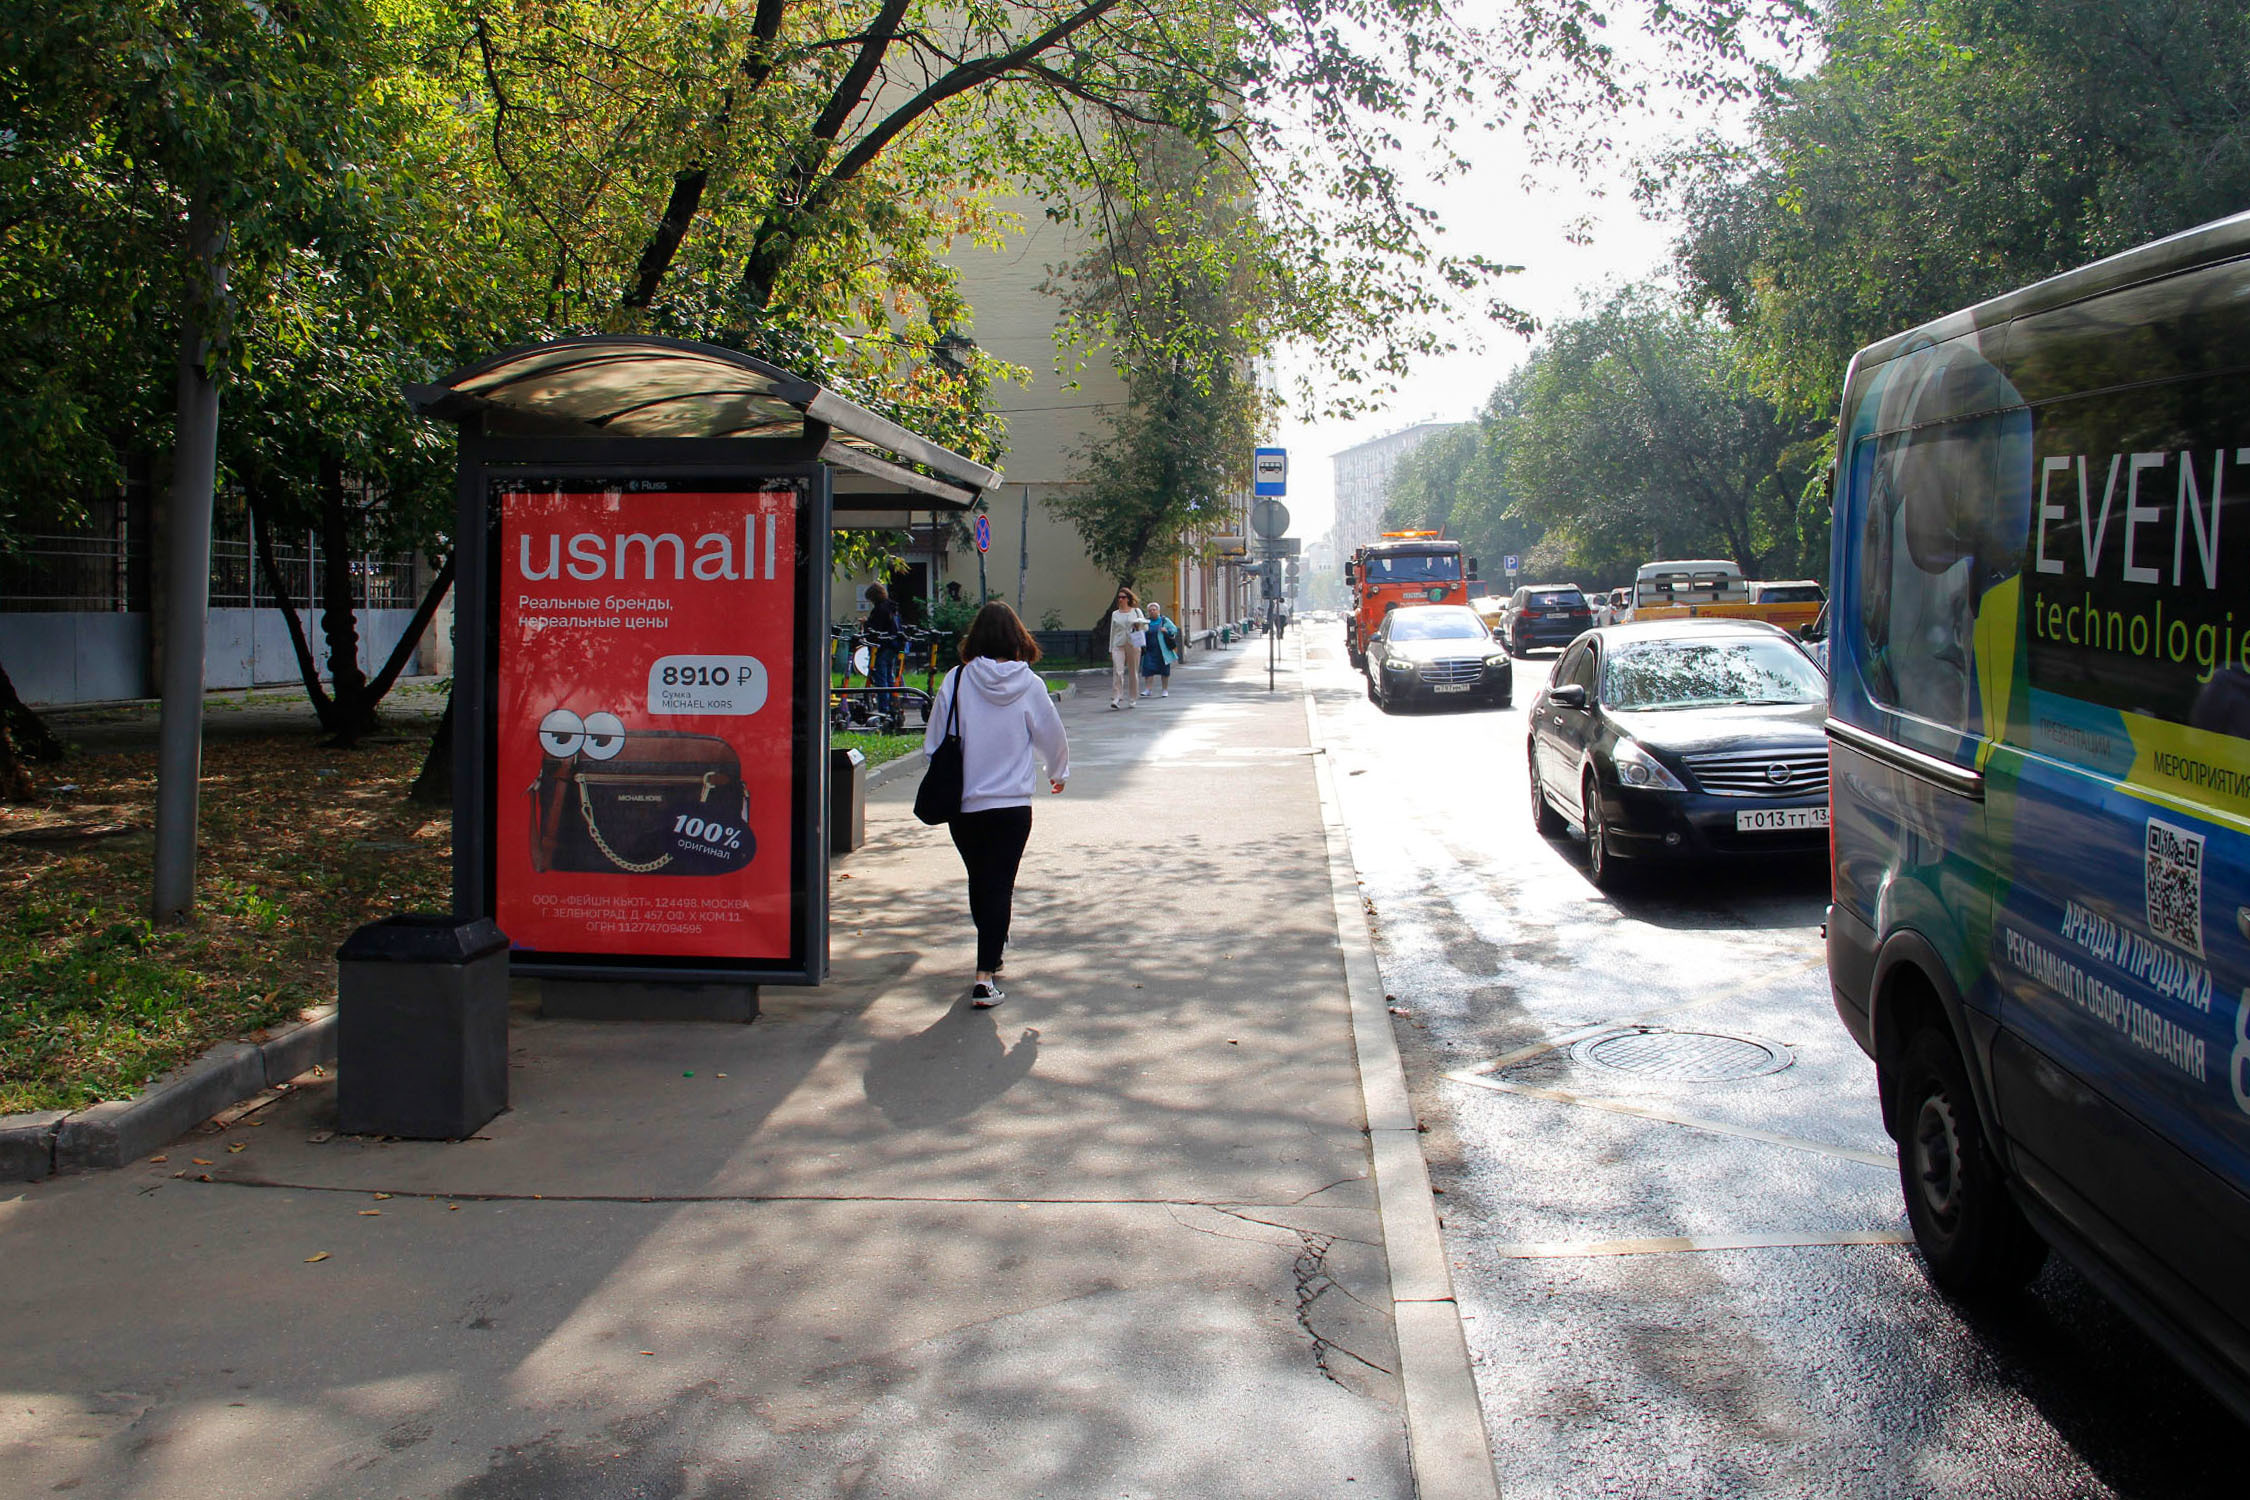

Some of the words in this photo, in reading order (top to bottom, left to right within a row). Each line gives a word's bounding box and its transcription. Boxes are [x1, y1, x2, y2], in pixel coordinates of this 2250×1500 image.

[641, 480, 667, 490] Russ
[519, 514, 776, 581] usmall
[519, 595, 600, 610] Реальные
[604, 595, 673, 612] бренды,
[518, 616, 620, 632] нереальные
[625, 616, 668, 630] цены
[662, 666, 730, 686] 8910
[662, 690, 691, 701] Сумка
[662, 700, 704, 709] MICHAEL
[707, 701, 733, 710] KORS
[2040, 718, 2111, 760] ПРЕЗЕНТАЦИИ
[1812, 809, 1829, 821] 13
[673, 814, 740, 849] 100%
[677, 838, 731, 861] оригинал
[532, 895, 557, 904] ООО
[585, 921, 616, 931] ОГРН
[2061, 900, 2115, 959] АРЕНДА
[2117, 926, 2129, 967] И
[2132, 935, 2212, 1013] ПРОДАЖА
[2006, 928, 2084, 1005] РЕКЛАМНОГО
[2087, 974, 2206, 1083] ОБОРУДОВАНИЯ
